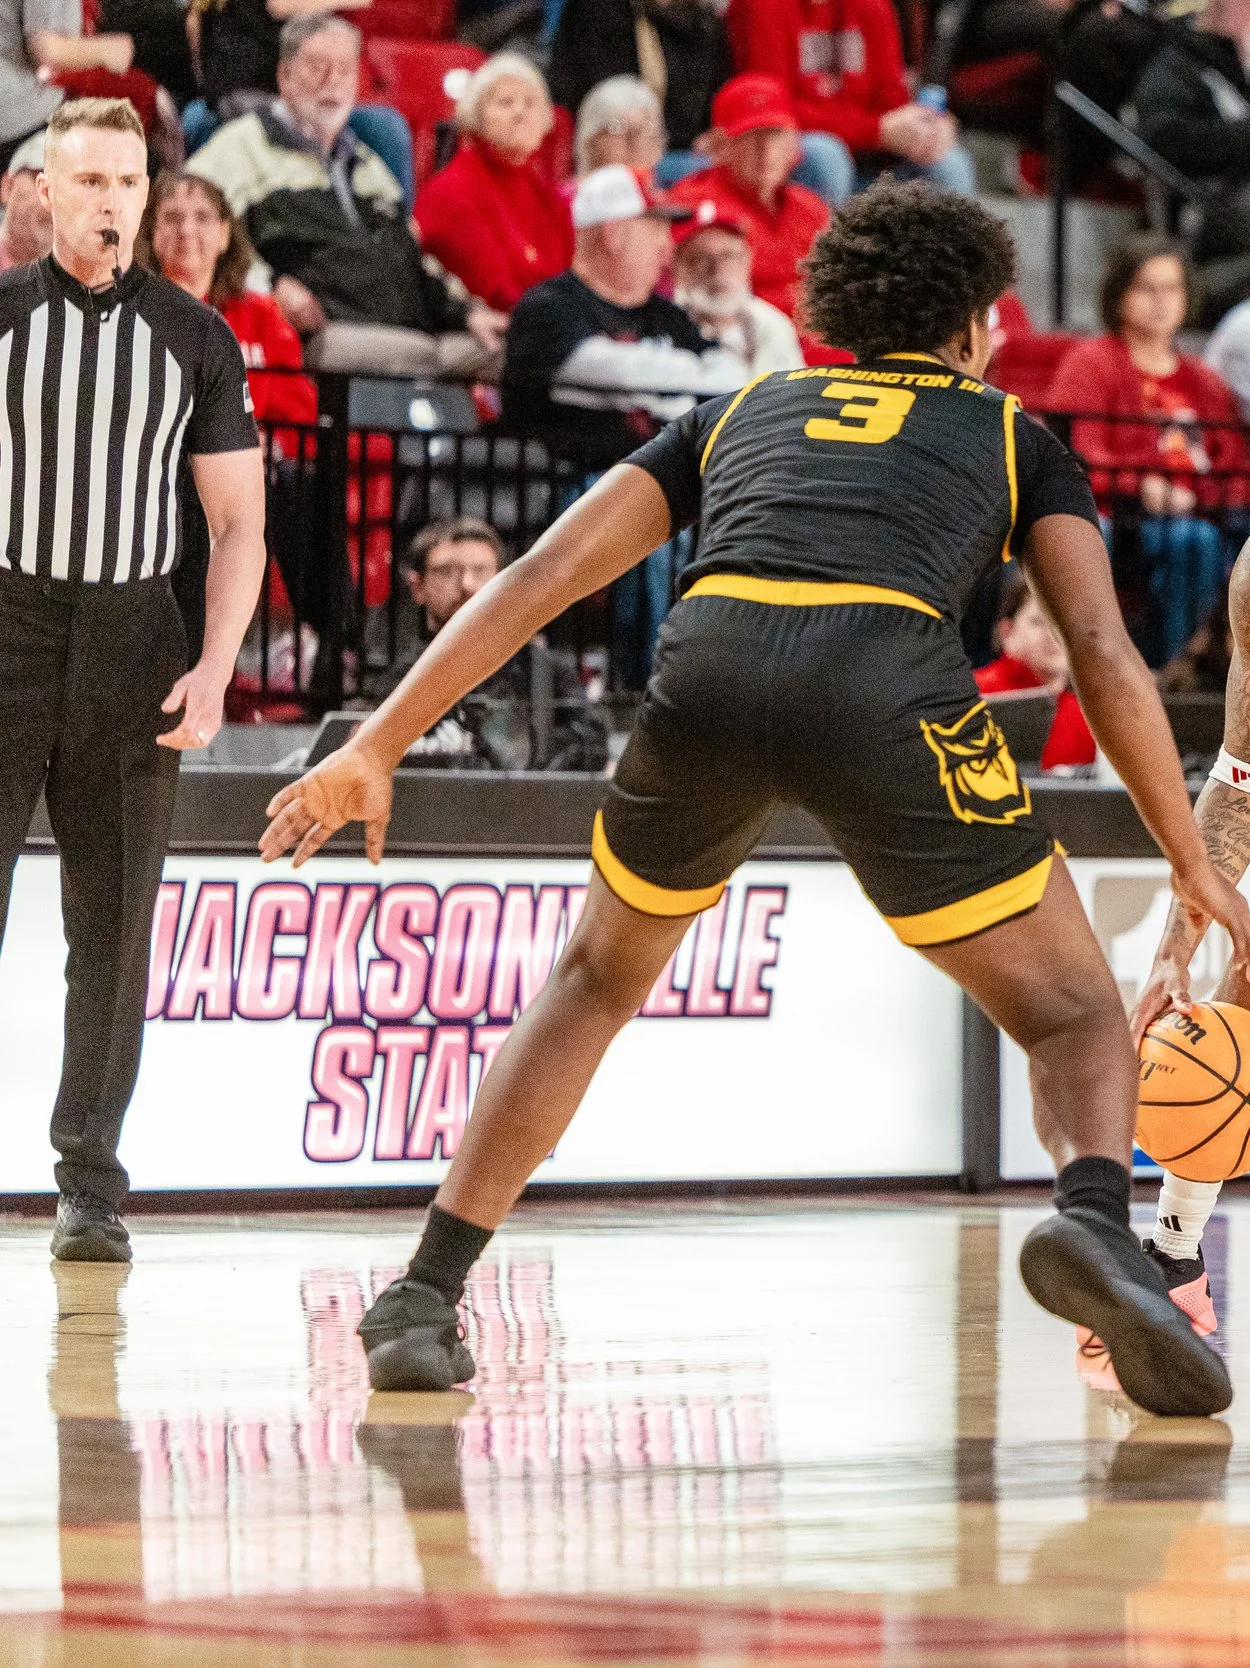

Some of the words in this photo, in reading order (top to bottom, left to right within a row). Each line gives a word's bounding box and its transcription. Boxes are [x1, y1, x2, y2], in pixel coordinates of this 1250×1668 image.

[786, 367, 954, 388] WASHINGTON
[958, 379, 986, 394] III
[804, 381, 917, 444] 3
[144, 880, 789, 1022] JACKSONLE
[302, 1024, 553, 1163] STA
